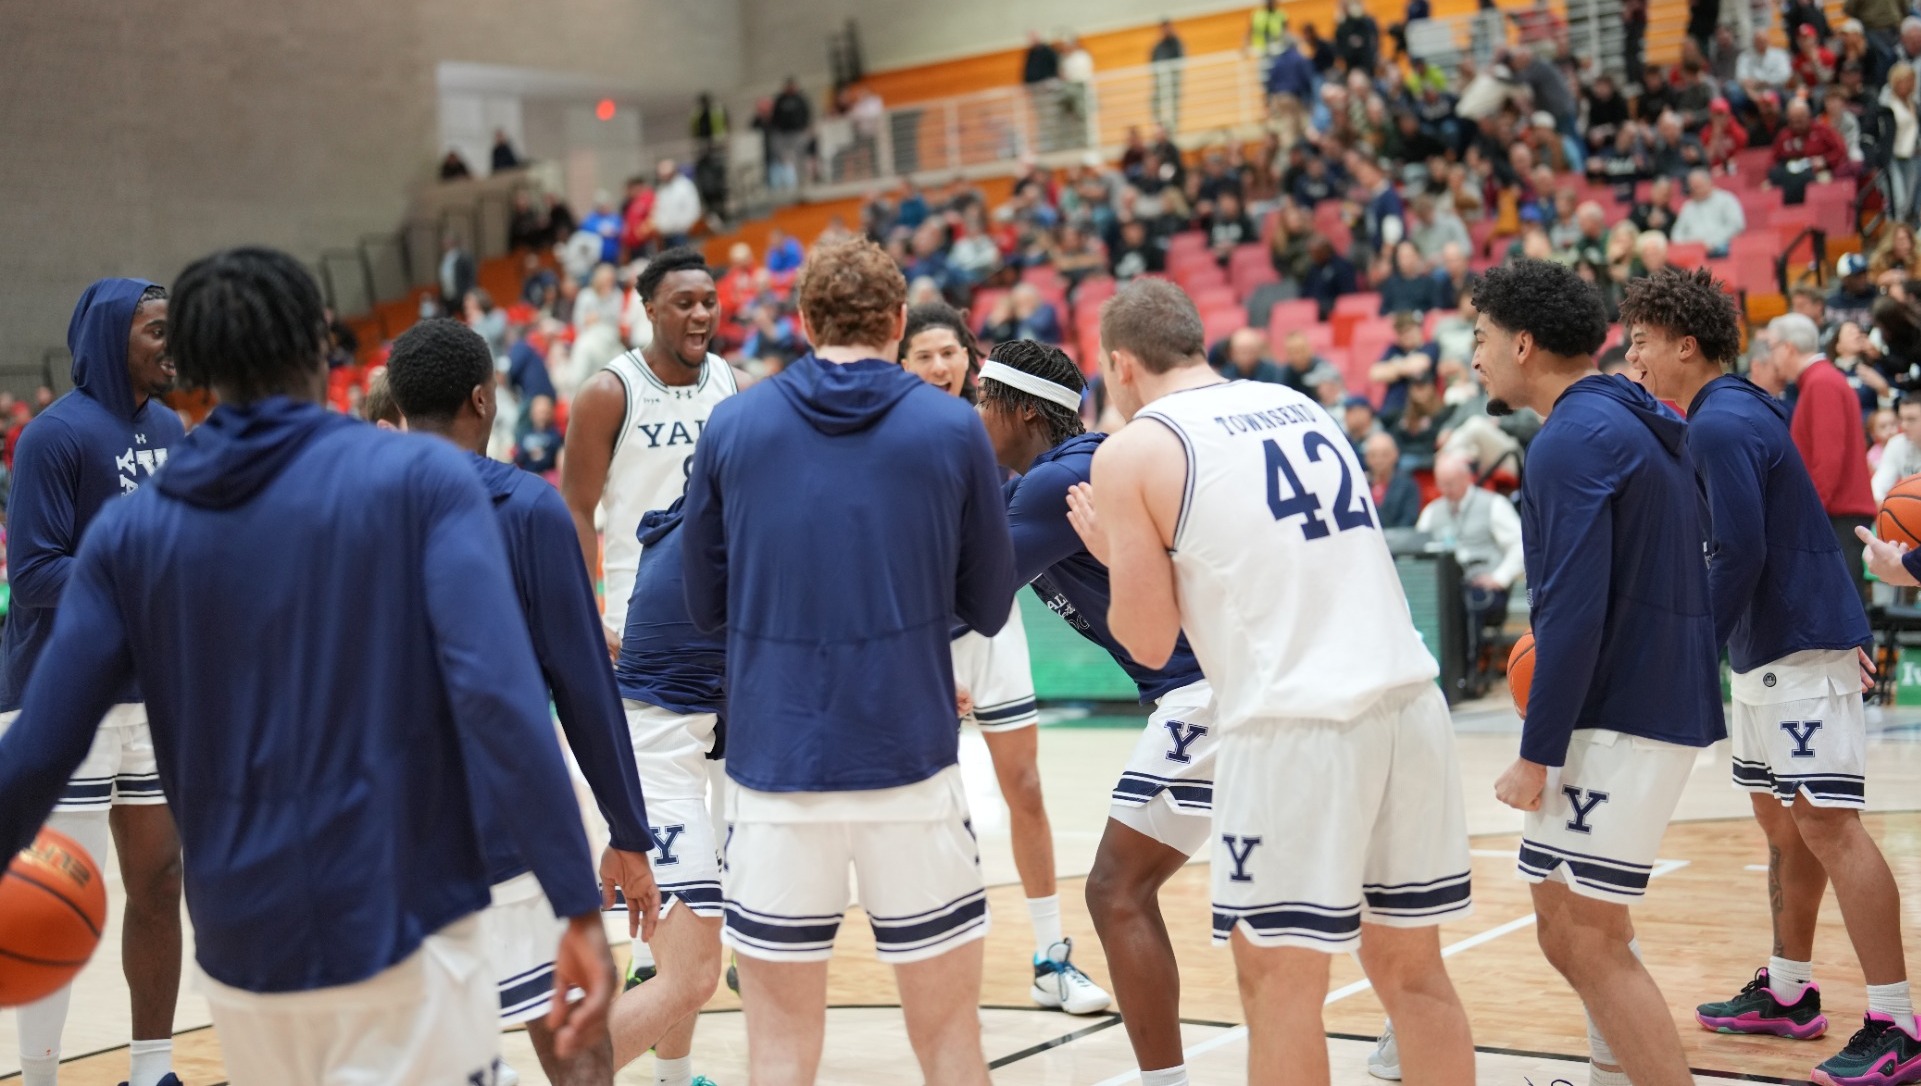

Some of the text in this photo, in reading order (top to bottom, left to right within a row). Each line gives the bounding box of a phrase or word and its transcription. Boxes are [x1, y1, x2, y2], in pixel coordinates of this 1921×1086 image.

[1213, 403, 1318, 436] TOWNSEND
[1262, 430, 1375, 541] 42
[1164, 719, 1209, 764] Y
[1780, 720, 1823, 758] Y
[1562, 784, 1610, 835] Y
[649, 824, 685, 867] Y
[1222, 833, 1263, 883] Y
